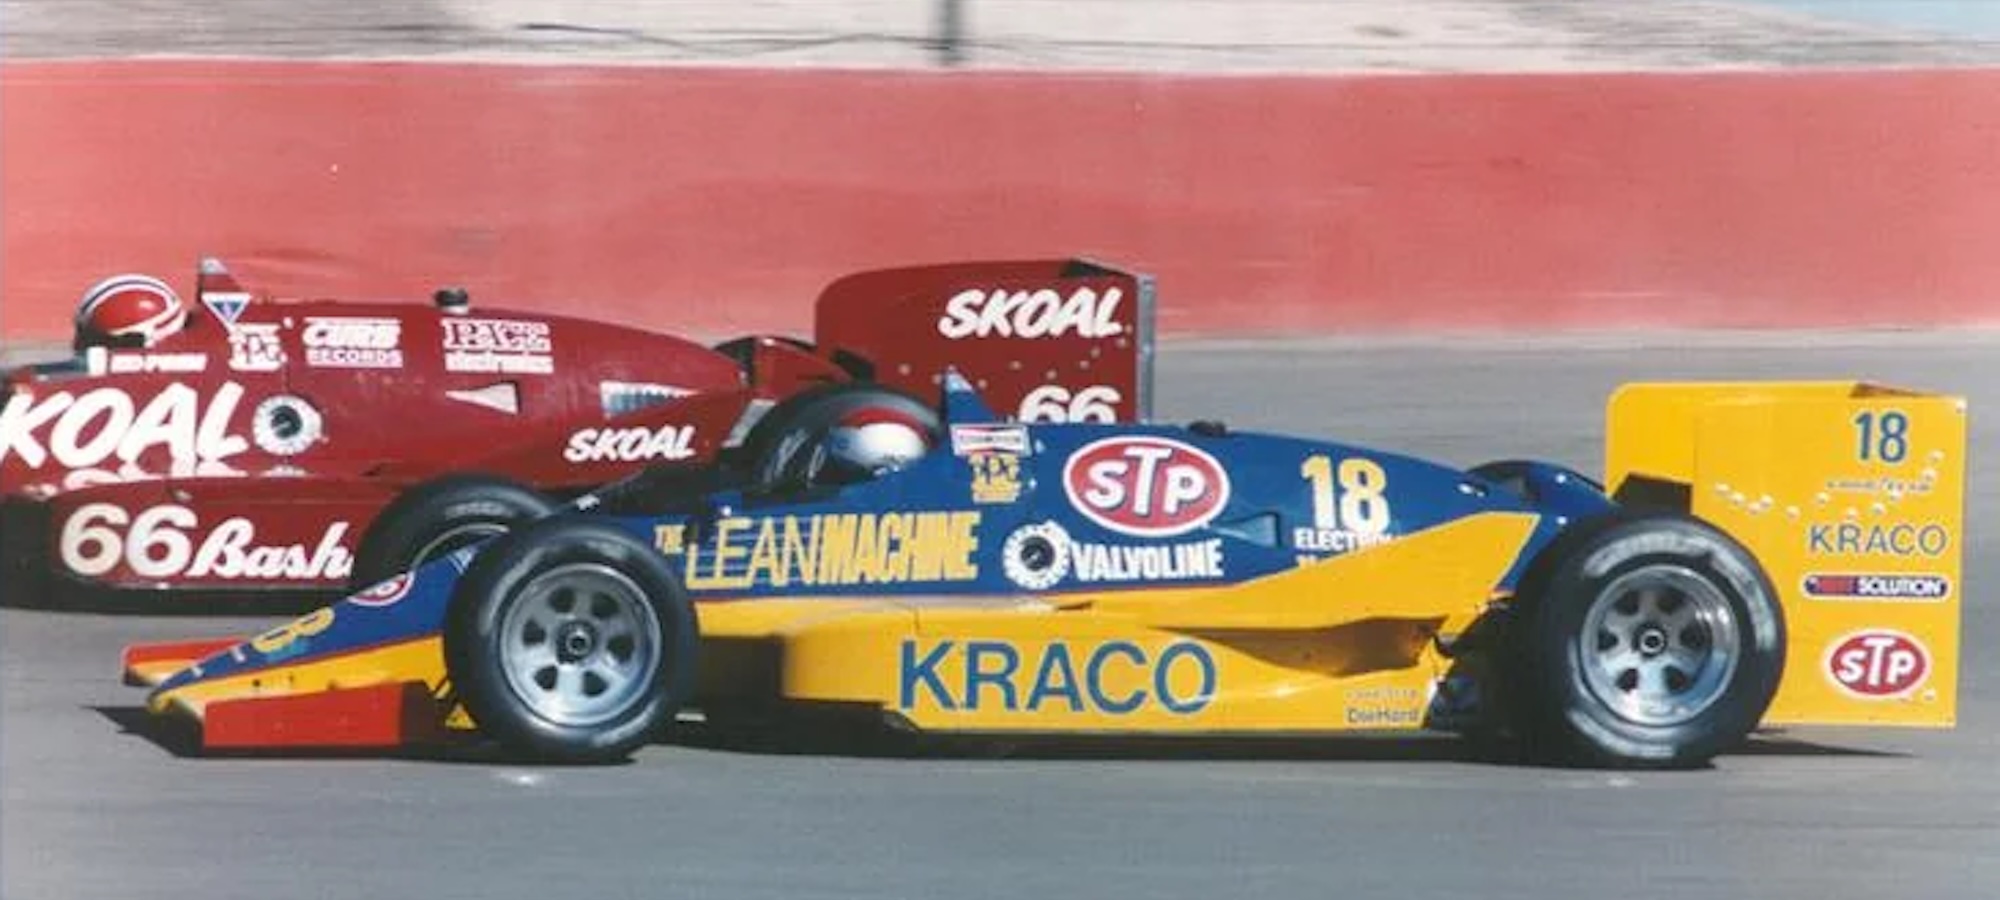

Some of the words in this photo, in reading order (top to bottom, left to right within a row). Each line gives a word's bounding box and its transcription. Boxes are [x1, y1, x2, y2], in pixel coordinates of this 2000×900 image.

[938, 286, 1122, 338] SKOAL
[563, 426, 696, 462] SKOAL
[1855, 411, 1908, 463] 18
[1084, 446, 1206, 516] STP
[1300, 453, 1391, 533] 18
[61, 502, 198, 577] 66
[186, 517, 355, 579] Bash
[1070, 539, 1225, 582] VALVOLINE
[1810, 524, 1947, 555] KRACO
[900, 639, 1217, 715] KRACO
[1837, 636, 1918, 686] STP
